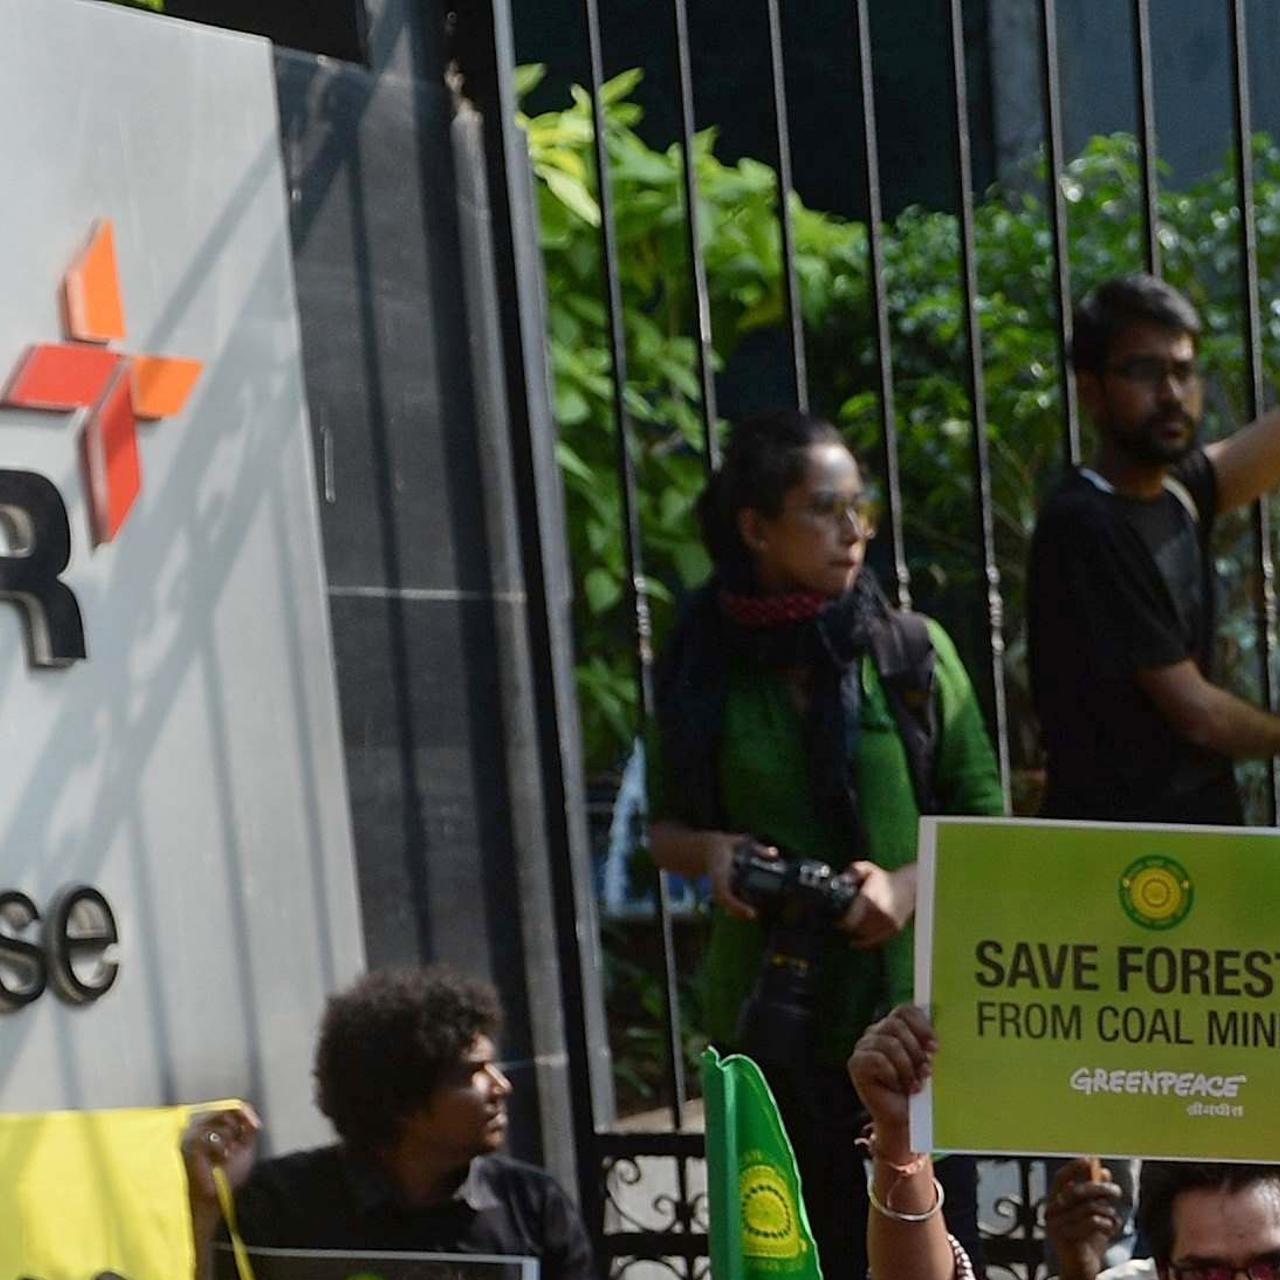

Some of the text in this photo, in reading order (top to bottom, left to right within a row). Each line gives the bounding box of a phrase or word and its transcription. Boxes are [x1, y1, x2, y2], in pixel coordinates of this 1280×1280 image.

[974, 940, 1100, 991] SAVE
[976, 1001, 1082, 1040] FROM
[1097, 1006, 1194, 1045] COAL
[1069, 1067, 1247, 1098] GREENPEACE
